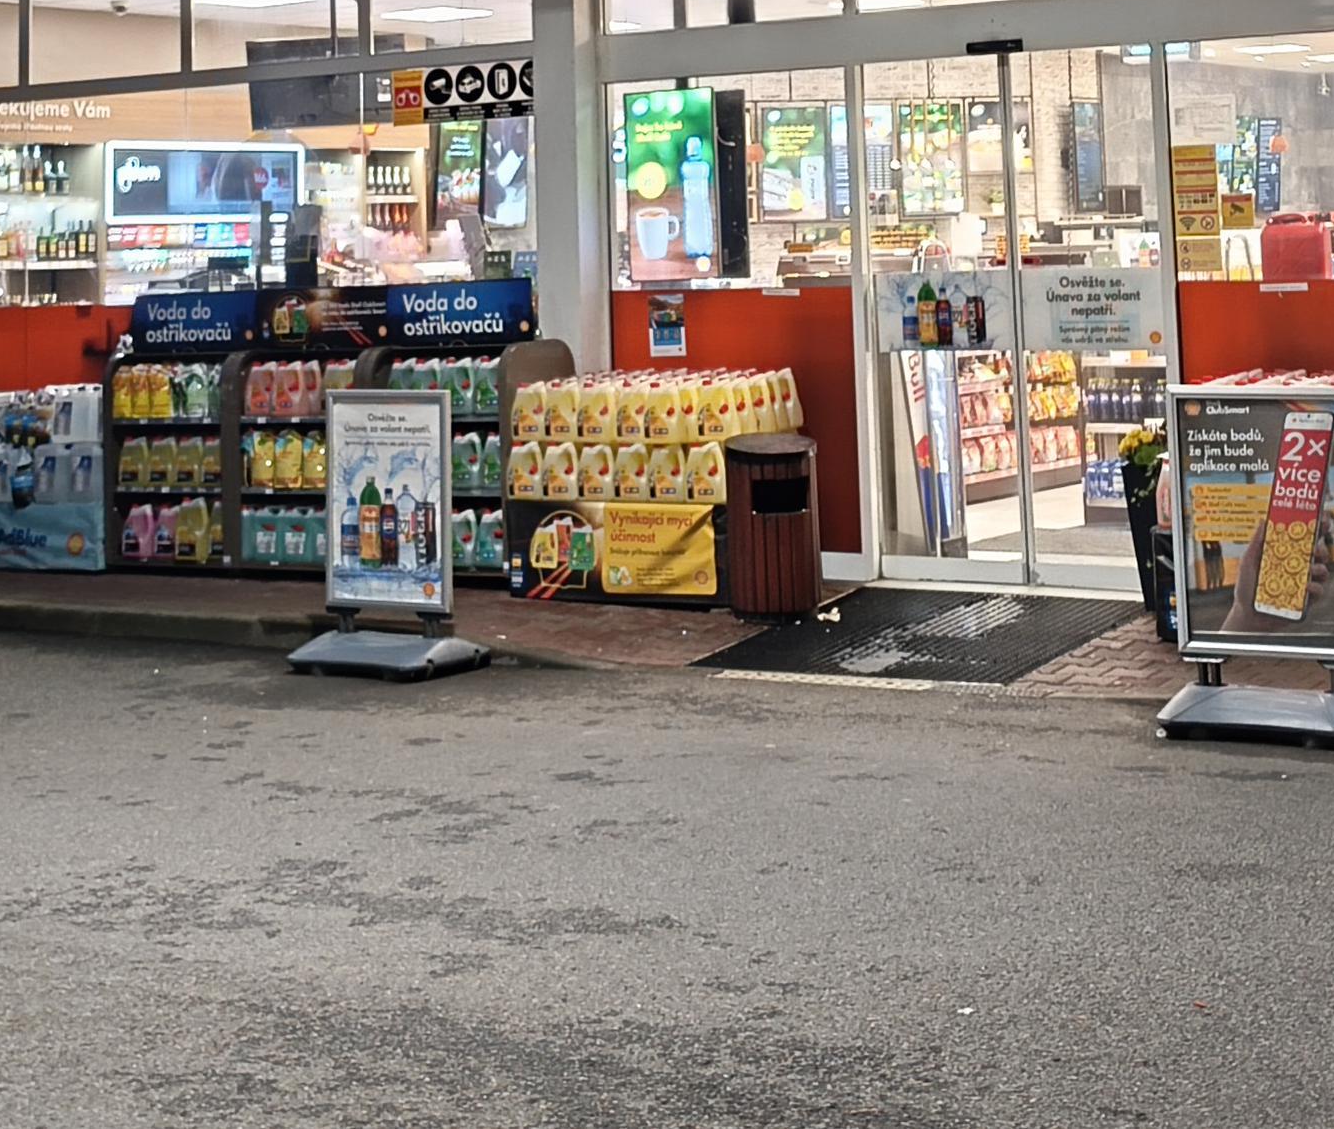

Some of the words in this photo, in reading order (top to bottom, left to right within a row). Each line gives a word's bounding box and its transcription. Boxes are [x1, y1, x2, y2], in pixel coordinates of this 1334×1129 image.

[72, 100, 111, 118] Vám
[1059, 275, 1106, 288] Osvěžte
[1110, 279, 1125, 287] se.
[402, 290, 448, 313] Voda
[453, 289, 478, 310] do
[1046, 287, 1083, 302] Únava
[1087, 293, 1101, 302] za
[1104, 289, 1141, 301] volant
[147, 300, 187, 321] Voda
[191, 299, 212, 320] do
[146, 322, 232, 343] ostřikovačů
[404, 312, 504, 336] ostřikovačů
[908, 353, 926, 403] Bull
[1187, 428, 1227, 442] Získáte
[1230, 428, 1265, 442] bodů,
[1189, 444, 1202, 456] že
[1204, 444, 1221, 460] jim
[1224, 444, 1254, 456] bude
[1189, 459, 1237, 474] aplikace
[1239, 458, 1269, 471] malá
[1278, 462, 1321, 483] více
[1274, 480, 1319, 499] bodů
[1272, 497, 1293, 509] celé
[1295, 498, 1317, 511] léto
[609, 511, 664, 528] Vynikající
[610, 529, 656, 543] účinnost
